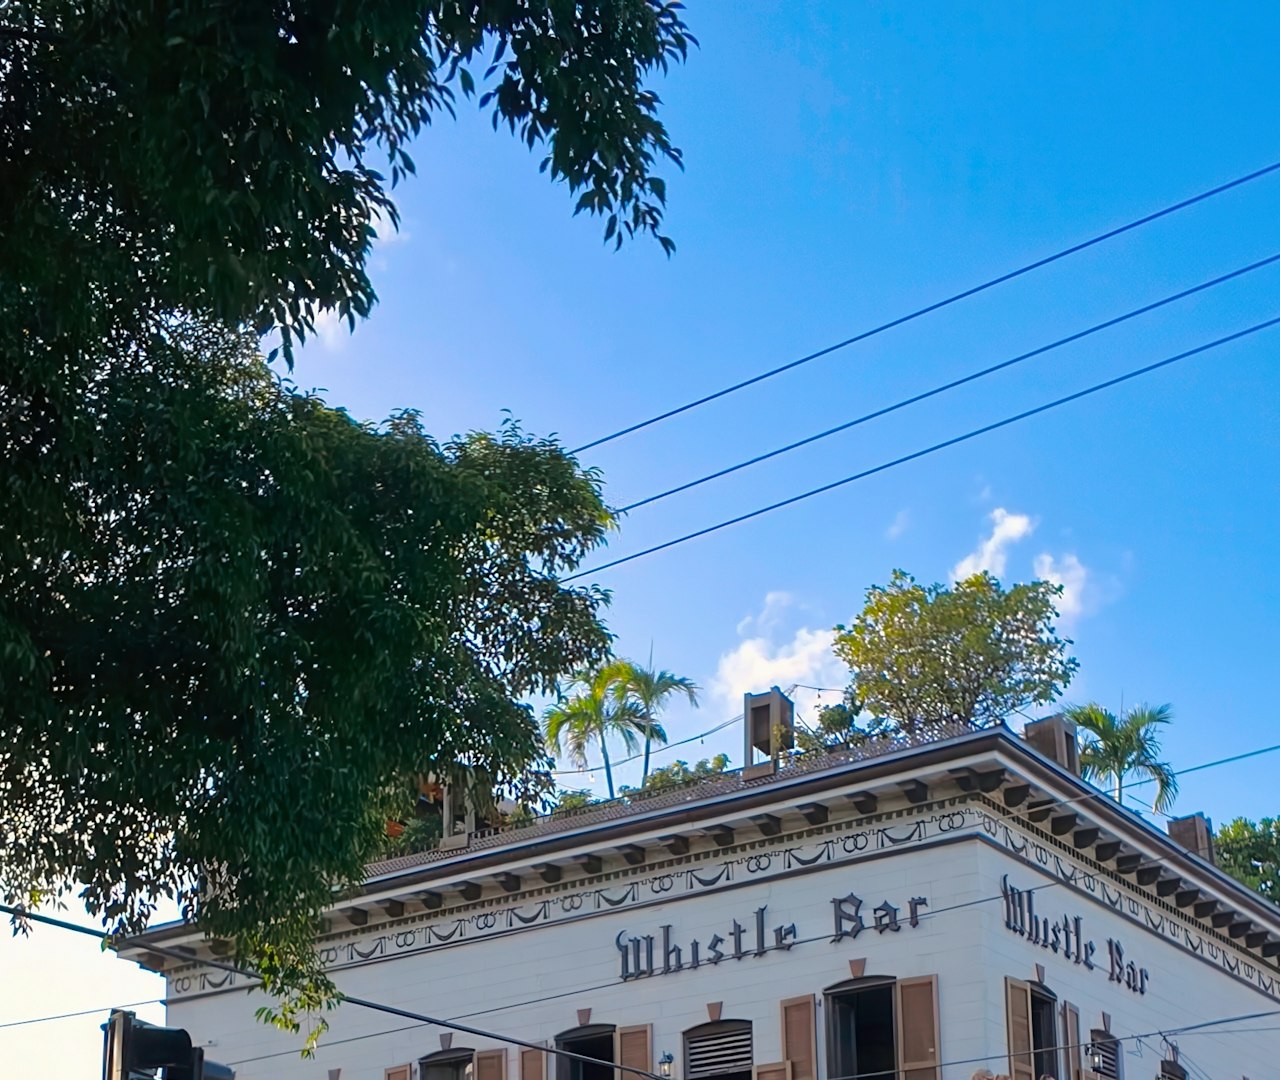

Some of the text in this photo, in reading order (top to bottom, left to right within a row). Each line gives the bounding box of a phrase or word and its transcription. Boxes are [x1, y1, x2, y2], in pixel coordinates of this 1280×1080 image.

[616, 892, 928, 981] Whistle Bar
[1000, 874, 1149, 995] Whistle Bar
